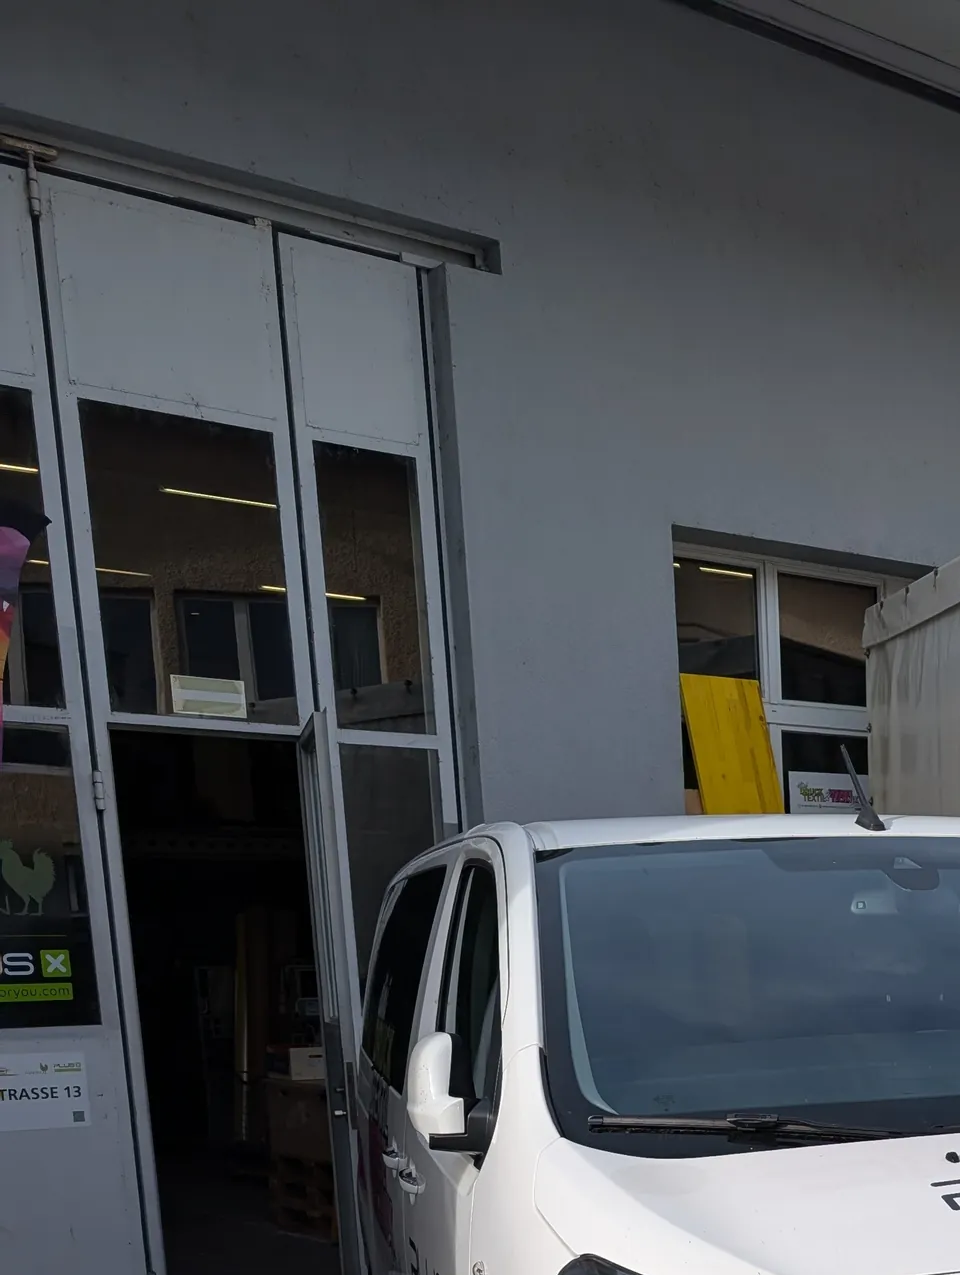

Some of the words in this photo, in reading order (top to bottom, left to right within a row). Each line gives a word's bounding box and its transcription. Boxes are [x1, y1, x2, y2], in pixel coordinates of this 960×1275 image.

[0, 952, 35, 976] S
[0, 1086, 59, 1101] TRASSE
[64, 1085, 82, 1099] 13
